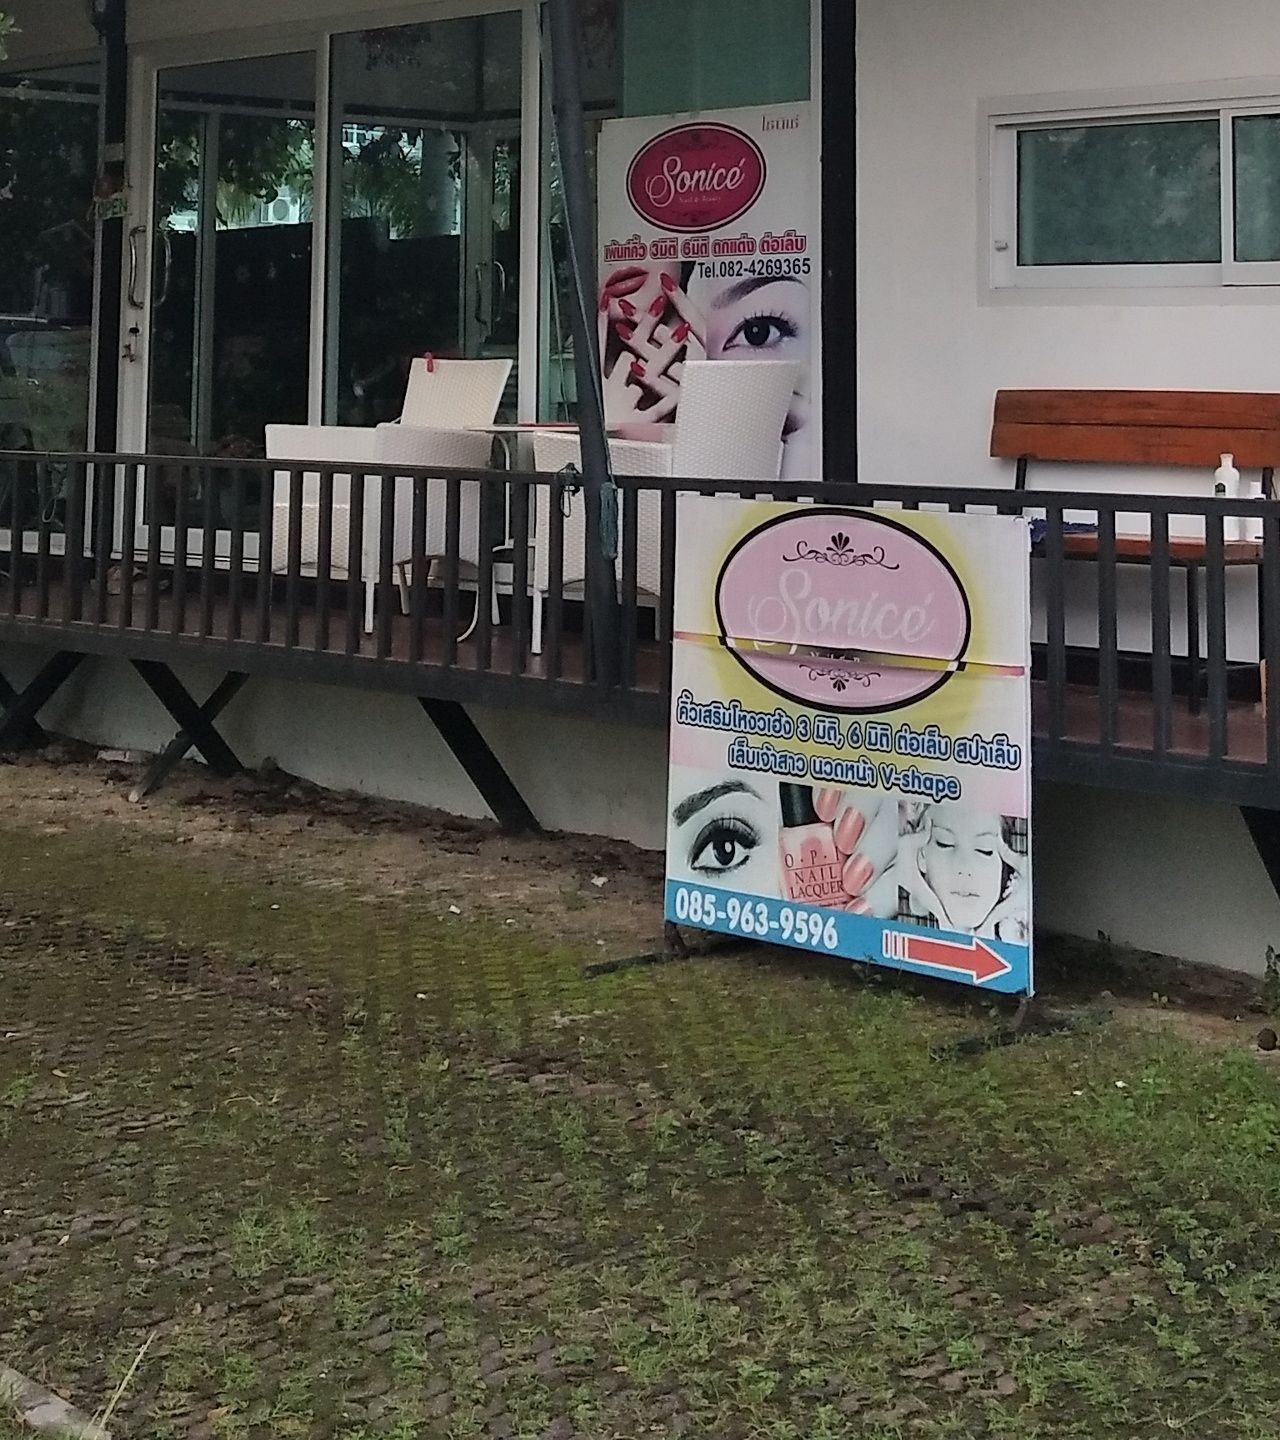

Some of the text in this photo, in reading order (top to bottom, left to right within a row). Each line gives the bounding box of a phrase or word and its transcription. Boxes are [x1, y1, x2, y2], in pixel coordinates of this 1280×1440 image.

[759, 230, 806, 255] ต่อเล็บ
[677, 691, 794, 739] คิ้วเสริมโหงวเฮ้ง
[796, 715, 811, 742] 3
[848, 721, 863, 749] 6
[865, 722, 892, 752] มิติ
[895, 724, 951, 761] ต่อเล็บ
[954, 734, 1021, 770] สปาเล็บ
[729, 737, 961, 803] เล็บเจ้าสาว นวดหน้า V-shape
[790, 880, 845, 899] LACQUER
[795, 867, 837, 884] NAIL
[675, 887, 838, 949] 085-963-9596
